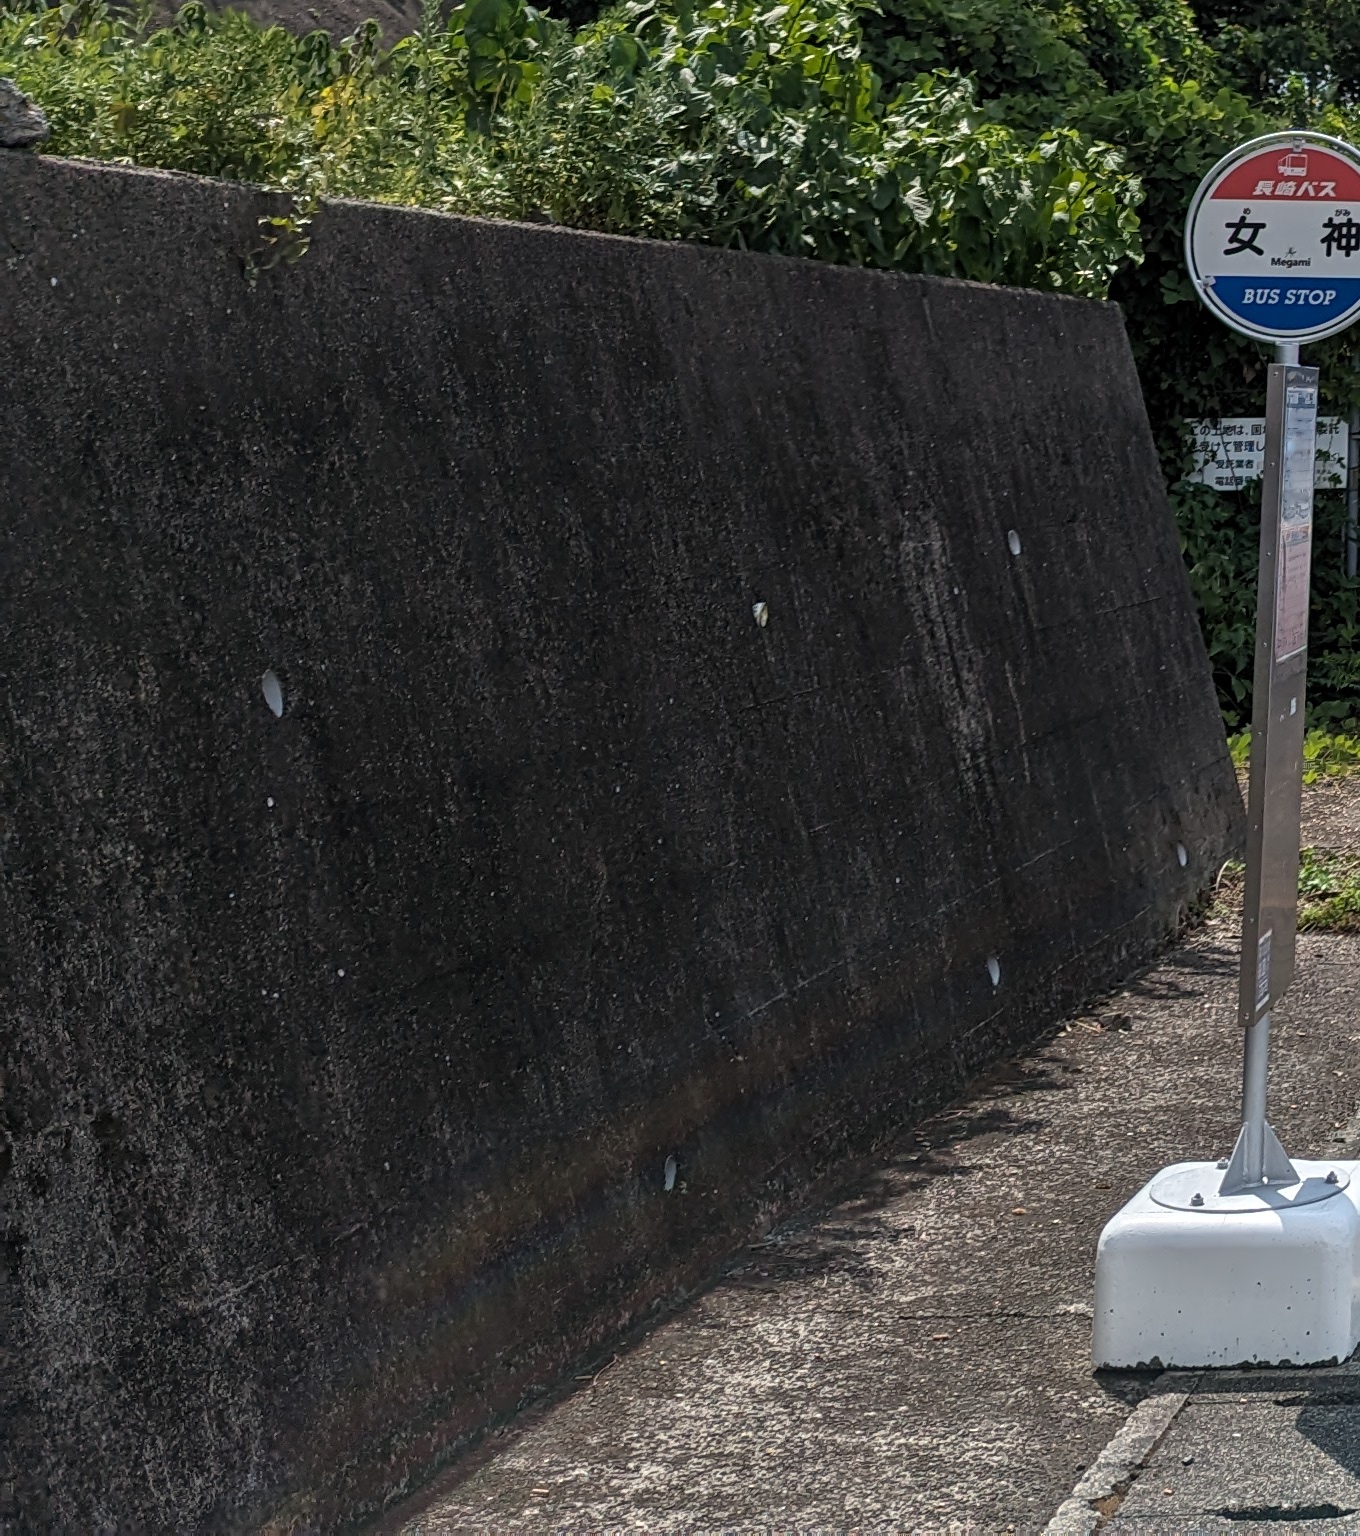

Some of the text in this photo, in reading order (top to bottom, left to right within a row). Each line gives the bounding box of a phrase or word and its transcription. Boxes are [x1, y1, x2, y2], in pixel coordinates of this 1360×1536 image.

[1252, 180, 1337, 197] 長崎バス
[1271, 257, 1311, 269] Megami
[1242, 289, 1337, 306] BUS STOP
